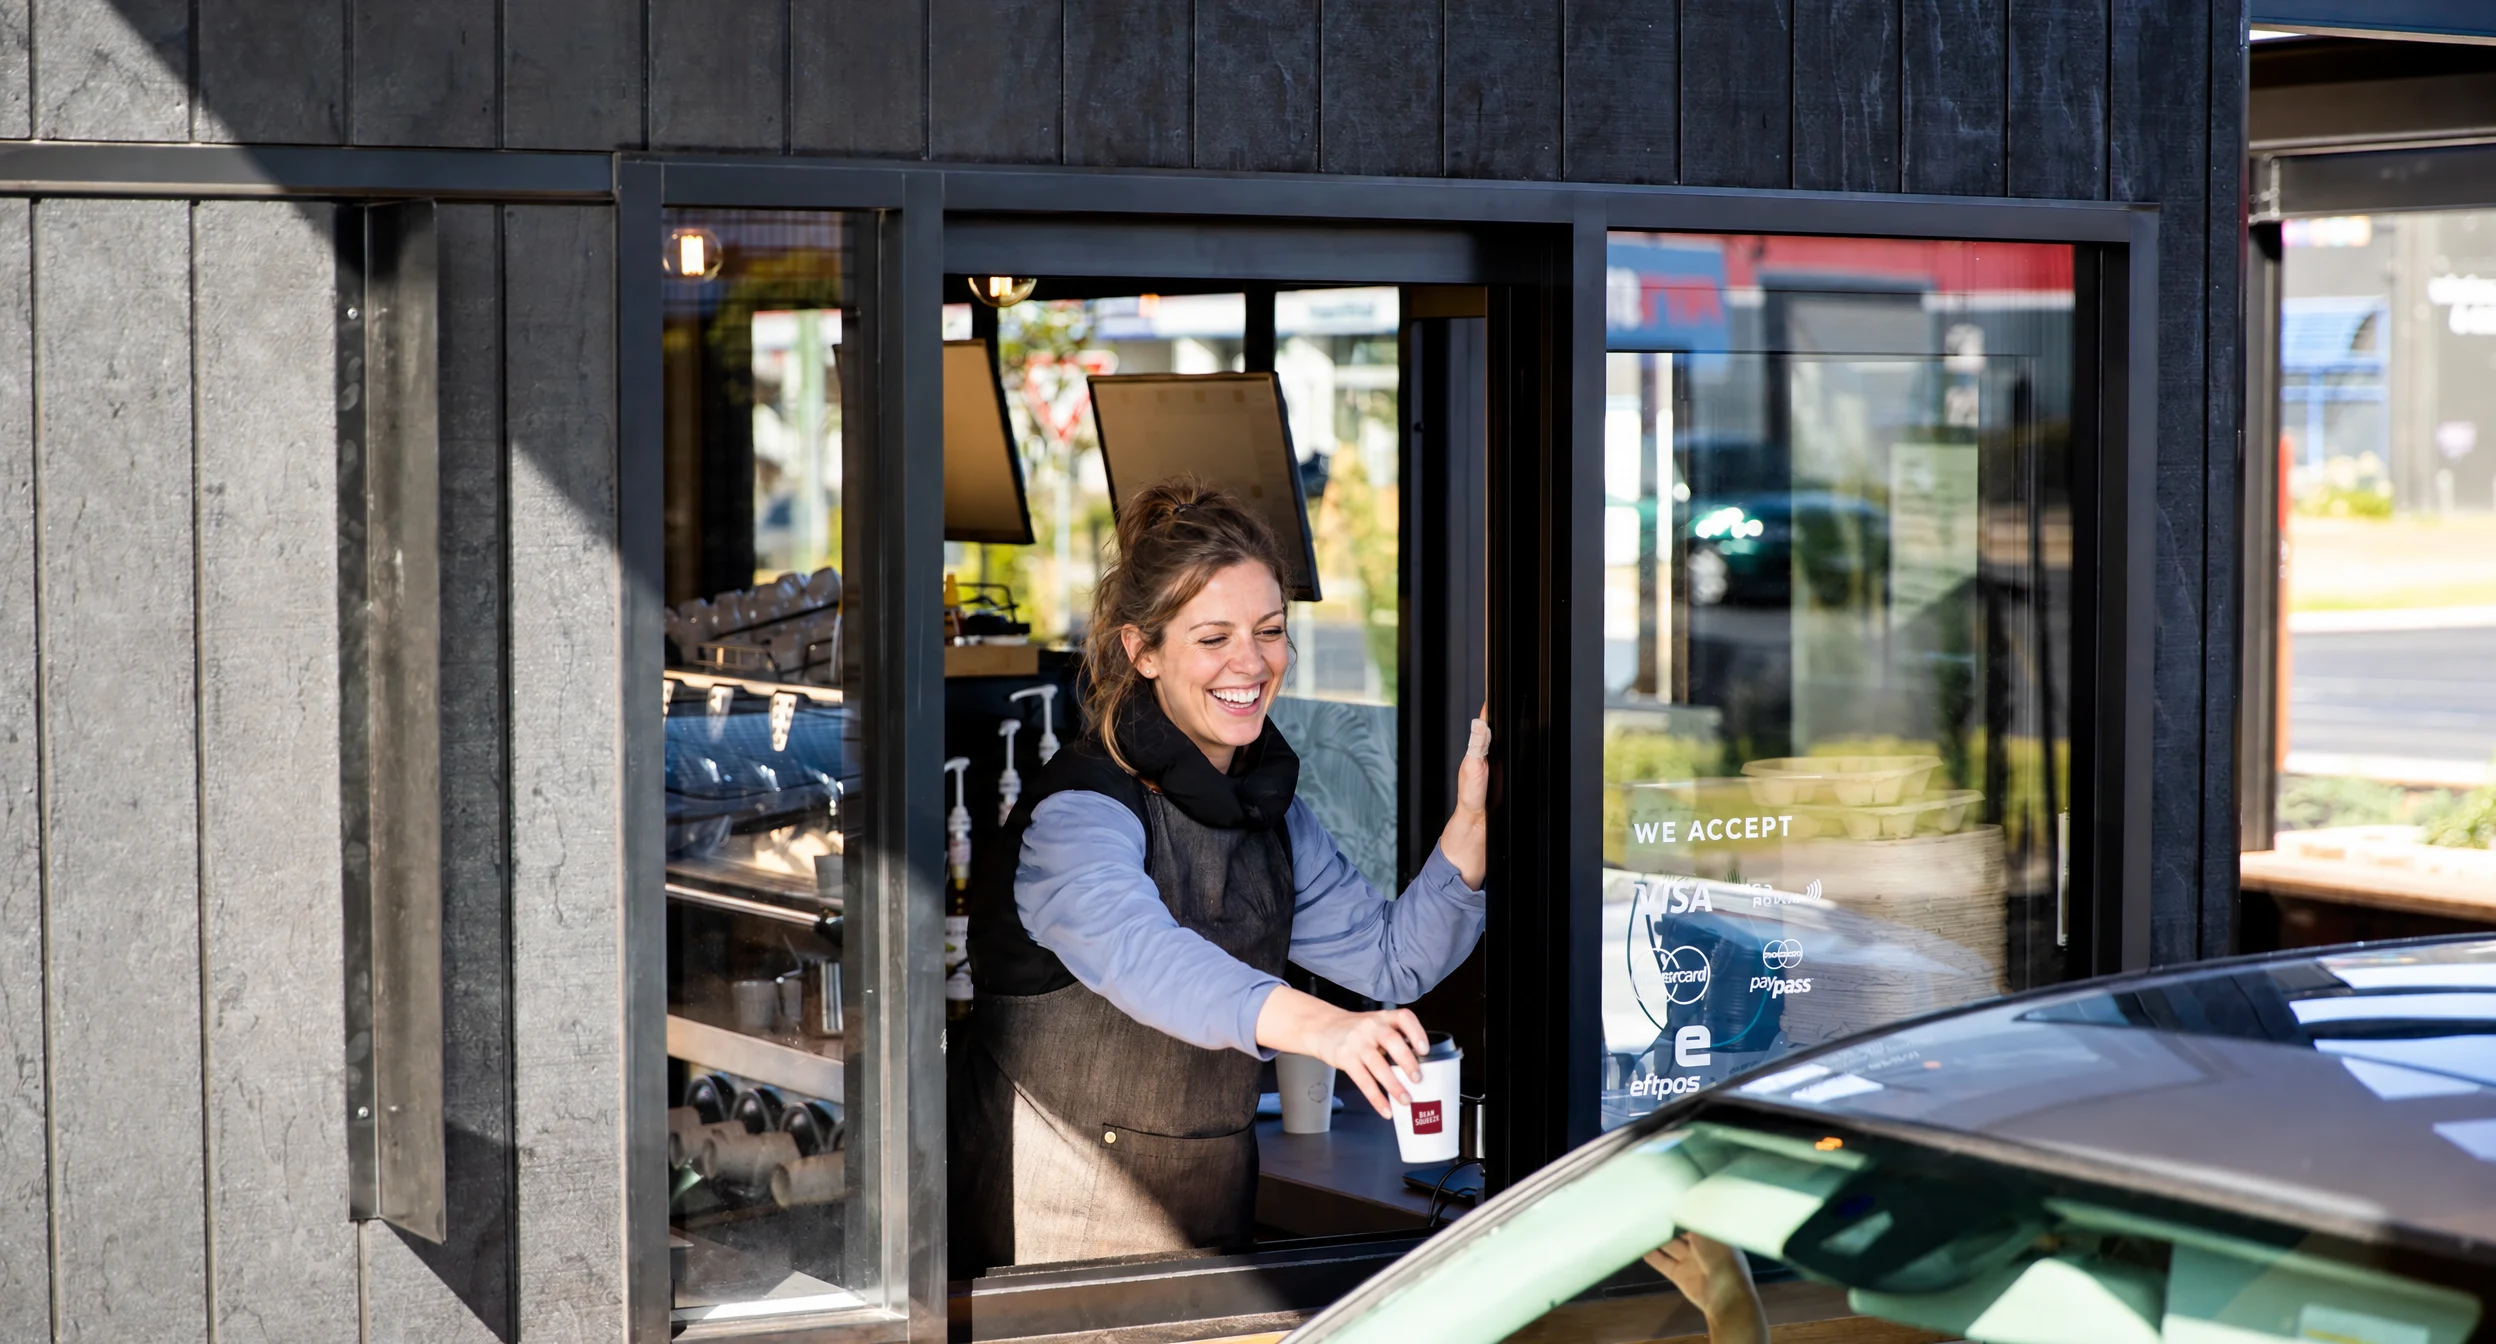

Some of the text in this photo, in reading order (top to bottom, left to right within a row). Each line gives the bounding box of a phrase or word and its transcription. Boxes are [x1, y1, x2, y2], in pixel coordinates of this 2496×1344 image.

[1633, 815, 1793, 844] WE ACCEPT
[1634, 879, 1713, 915] VISA
[1629, 1073, 1701, 1101] eftpos
[1414, 1114, 1440, 1126] SQUEEZE
[1418, 1109, 1435, 1119] BEAN
